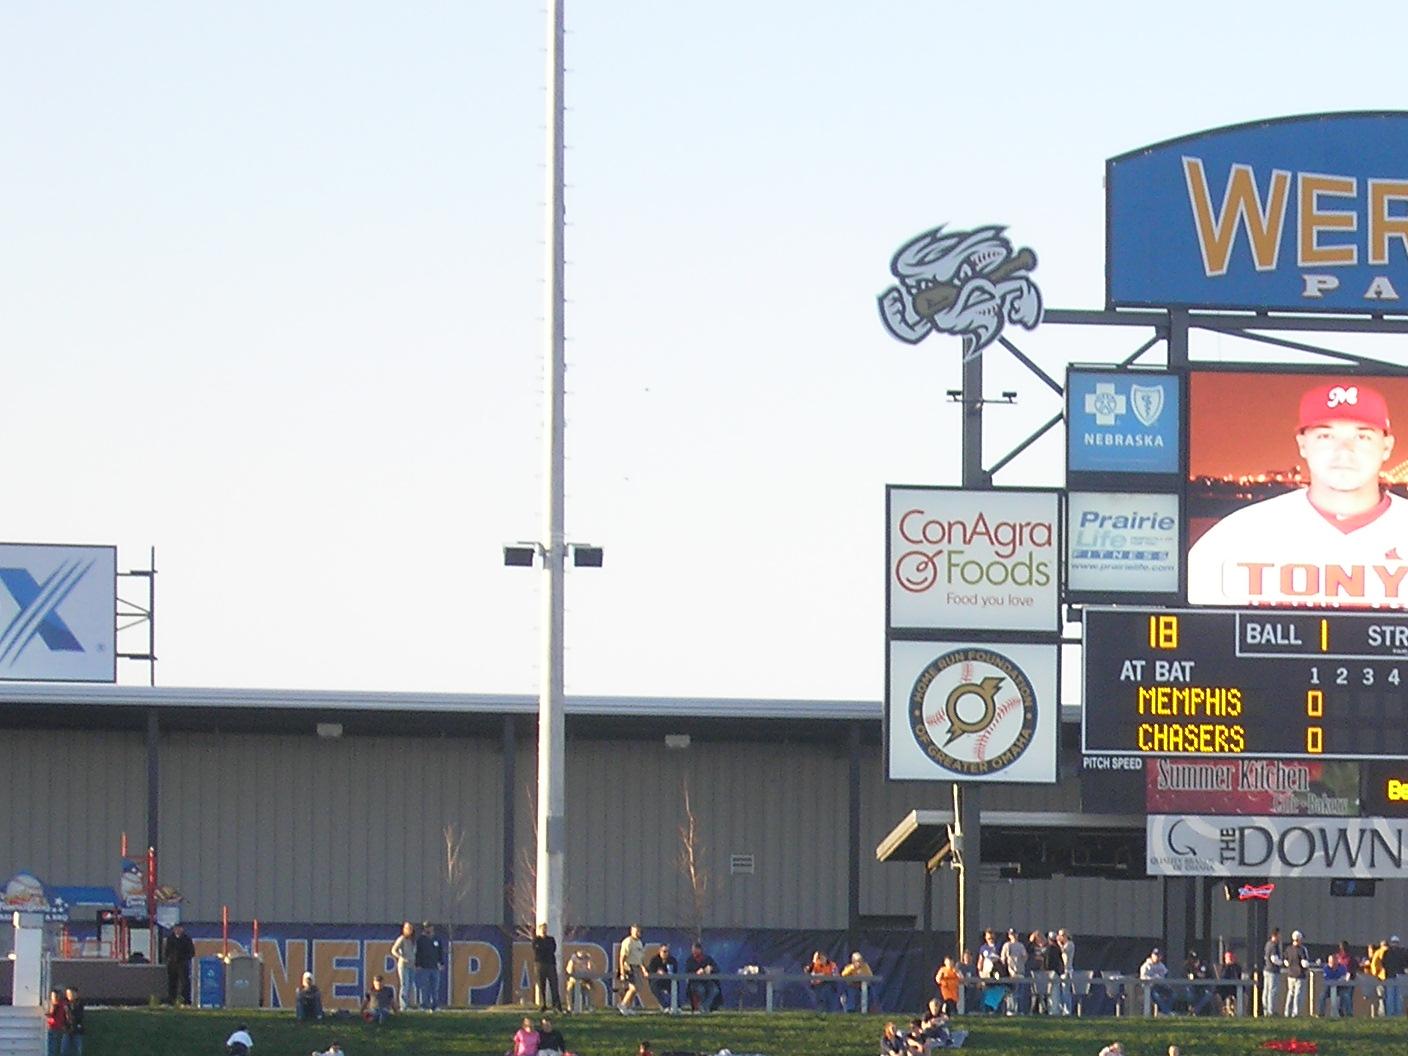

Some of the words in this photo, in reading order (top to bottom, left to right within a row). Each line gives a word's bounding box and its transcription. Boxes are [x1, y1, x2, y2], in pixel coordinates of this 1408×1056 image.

[1084, 432, 1164, 448] NEBRASKA
[899, 509, 1052, 559] ConAgra
[1080, 510, 1175, 531] Prairie
[1075, 529, 1128, 548] Life
[947, 550, 1050, 587] Foods
[947, 592, 978, 605] Food
[981, 595, 1004, 608] you
[1008, 594, 1034, 607] love
[1150, 615, 1178, 649] 18
[1246, 623, 1302, 645] BALL
[1321, 619, 1327, 652] 1
[914, 667, 937, 703] HOME
[938, 650, 965, 670] RUN
[968, 650, 1033, 708] FOUNDATION
[1120, 660, 1145, 681] AT
[1155, 661, 1195, 682] BAT
[1310, 668, 1319, 685] 1
[1335, 668, 1348, 685] 2
[1363, 668, 1374, 685] 3
[1388, 668, 1400, 686] 4
[1138, 686, 1242, 717] MEMPHIS
[1307, 690, 1323, 717] 0
[915, 724, 930, 743] OF
[927, 745, 988, 773] GREATER
[992, 729, 1032, 769] OMAHA
[1138, 723, 1245, 752] CHASERS
[1307, 727, 1323, 753] 0
[1083, 757, 1110, 769] PITCH
[1112, 758, 1142, 770] SPEED
[1157, 758, 1235, 790] Summer
[1238, 759, 1309, 792] Kitchen
[1220, 828, 1236, 864] THE
